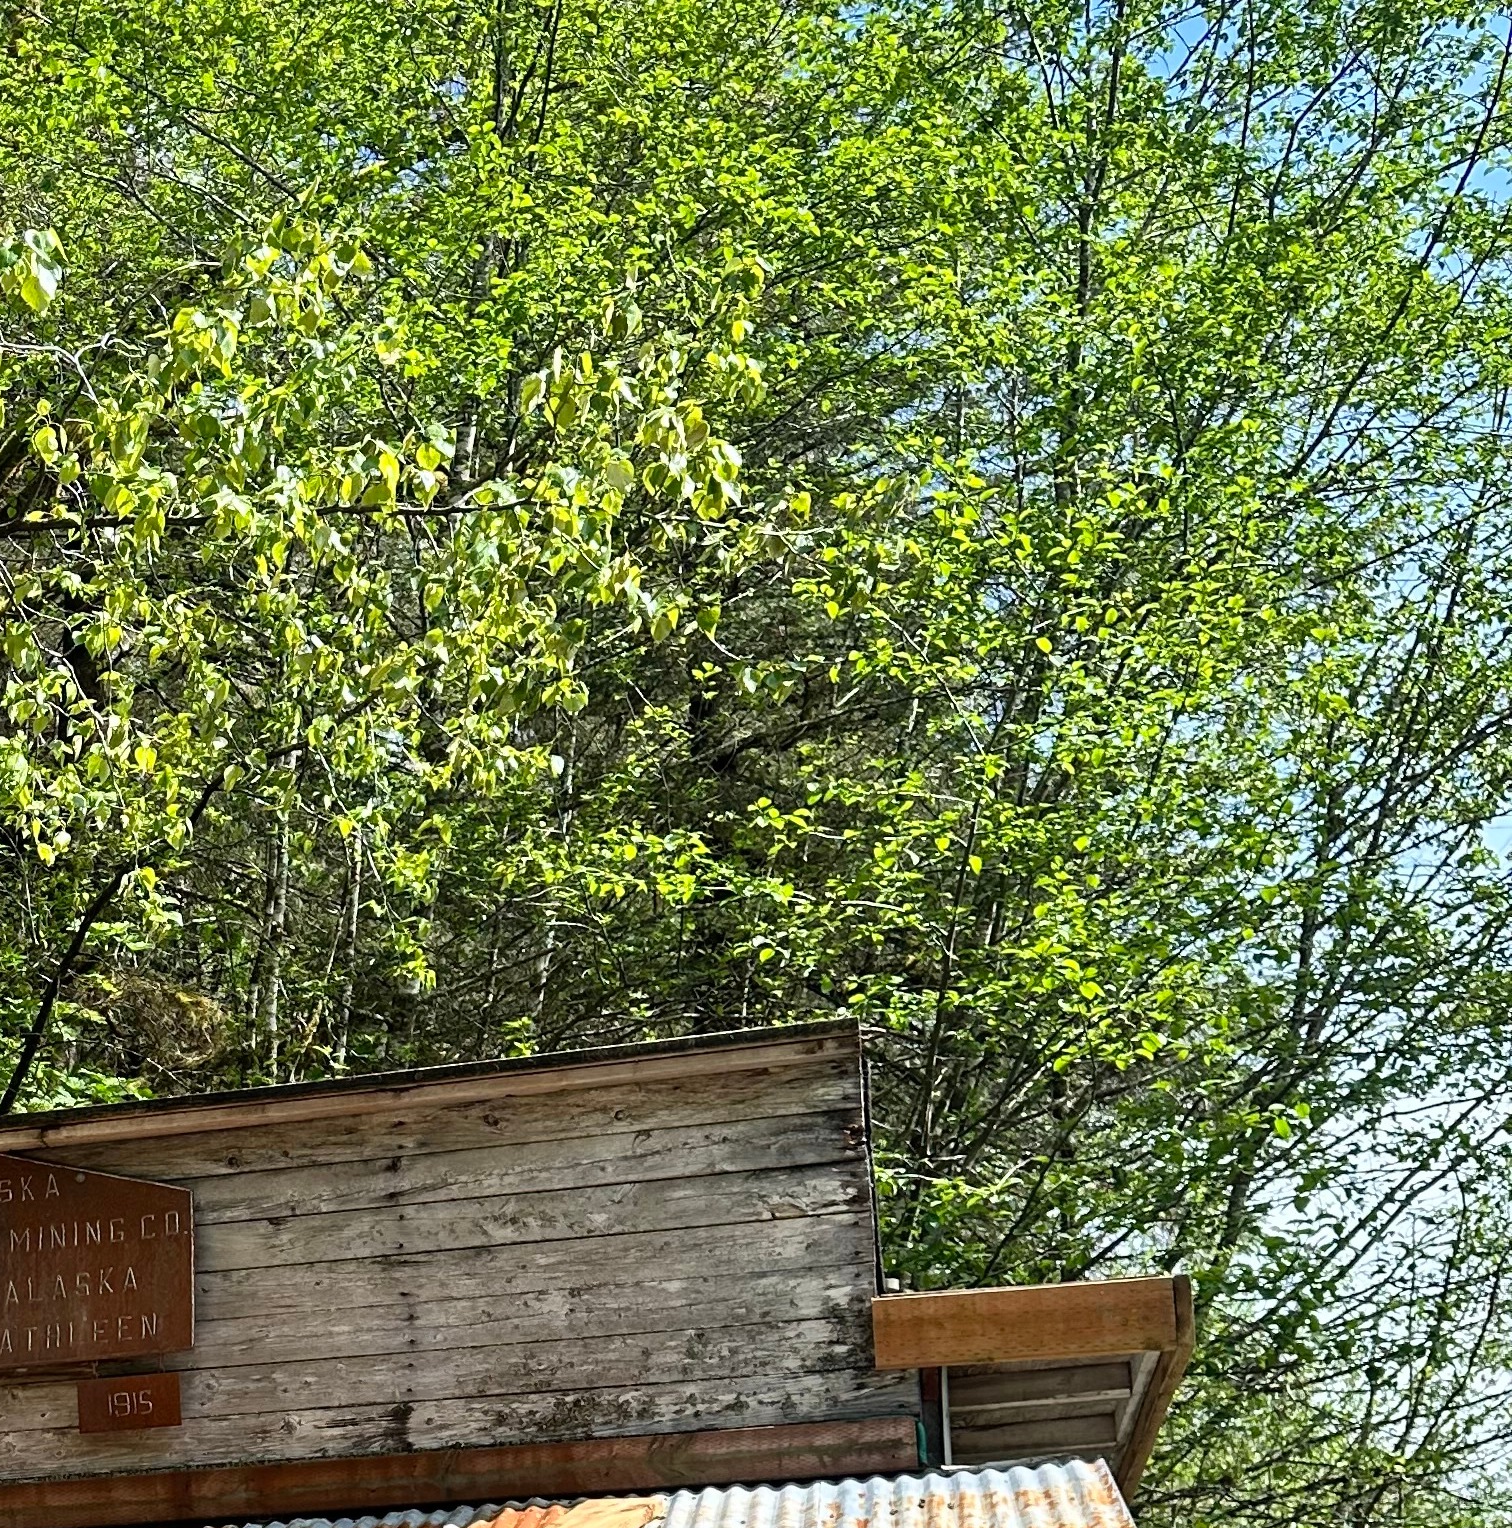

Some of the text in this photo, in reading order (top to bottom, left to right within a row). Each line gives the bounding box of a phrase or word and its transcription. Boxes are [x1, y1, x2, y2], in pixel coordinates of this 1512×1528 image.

[10, 1218, 124, 1252] MINING
[141, 1211, 188, 1240] CO.
[4, 1266, 138, 1306] ALASKA
[107, 1389, 153, 1418] 1915
